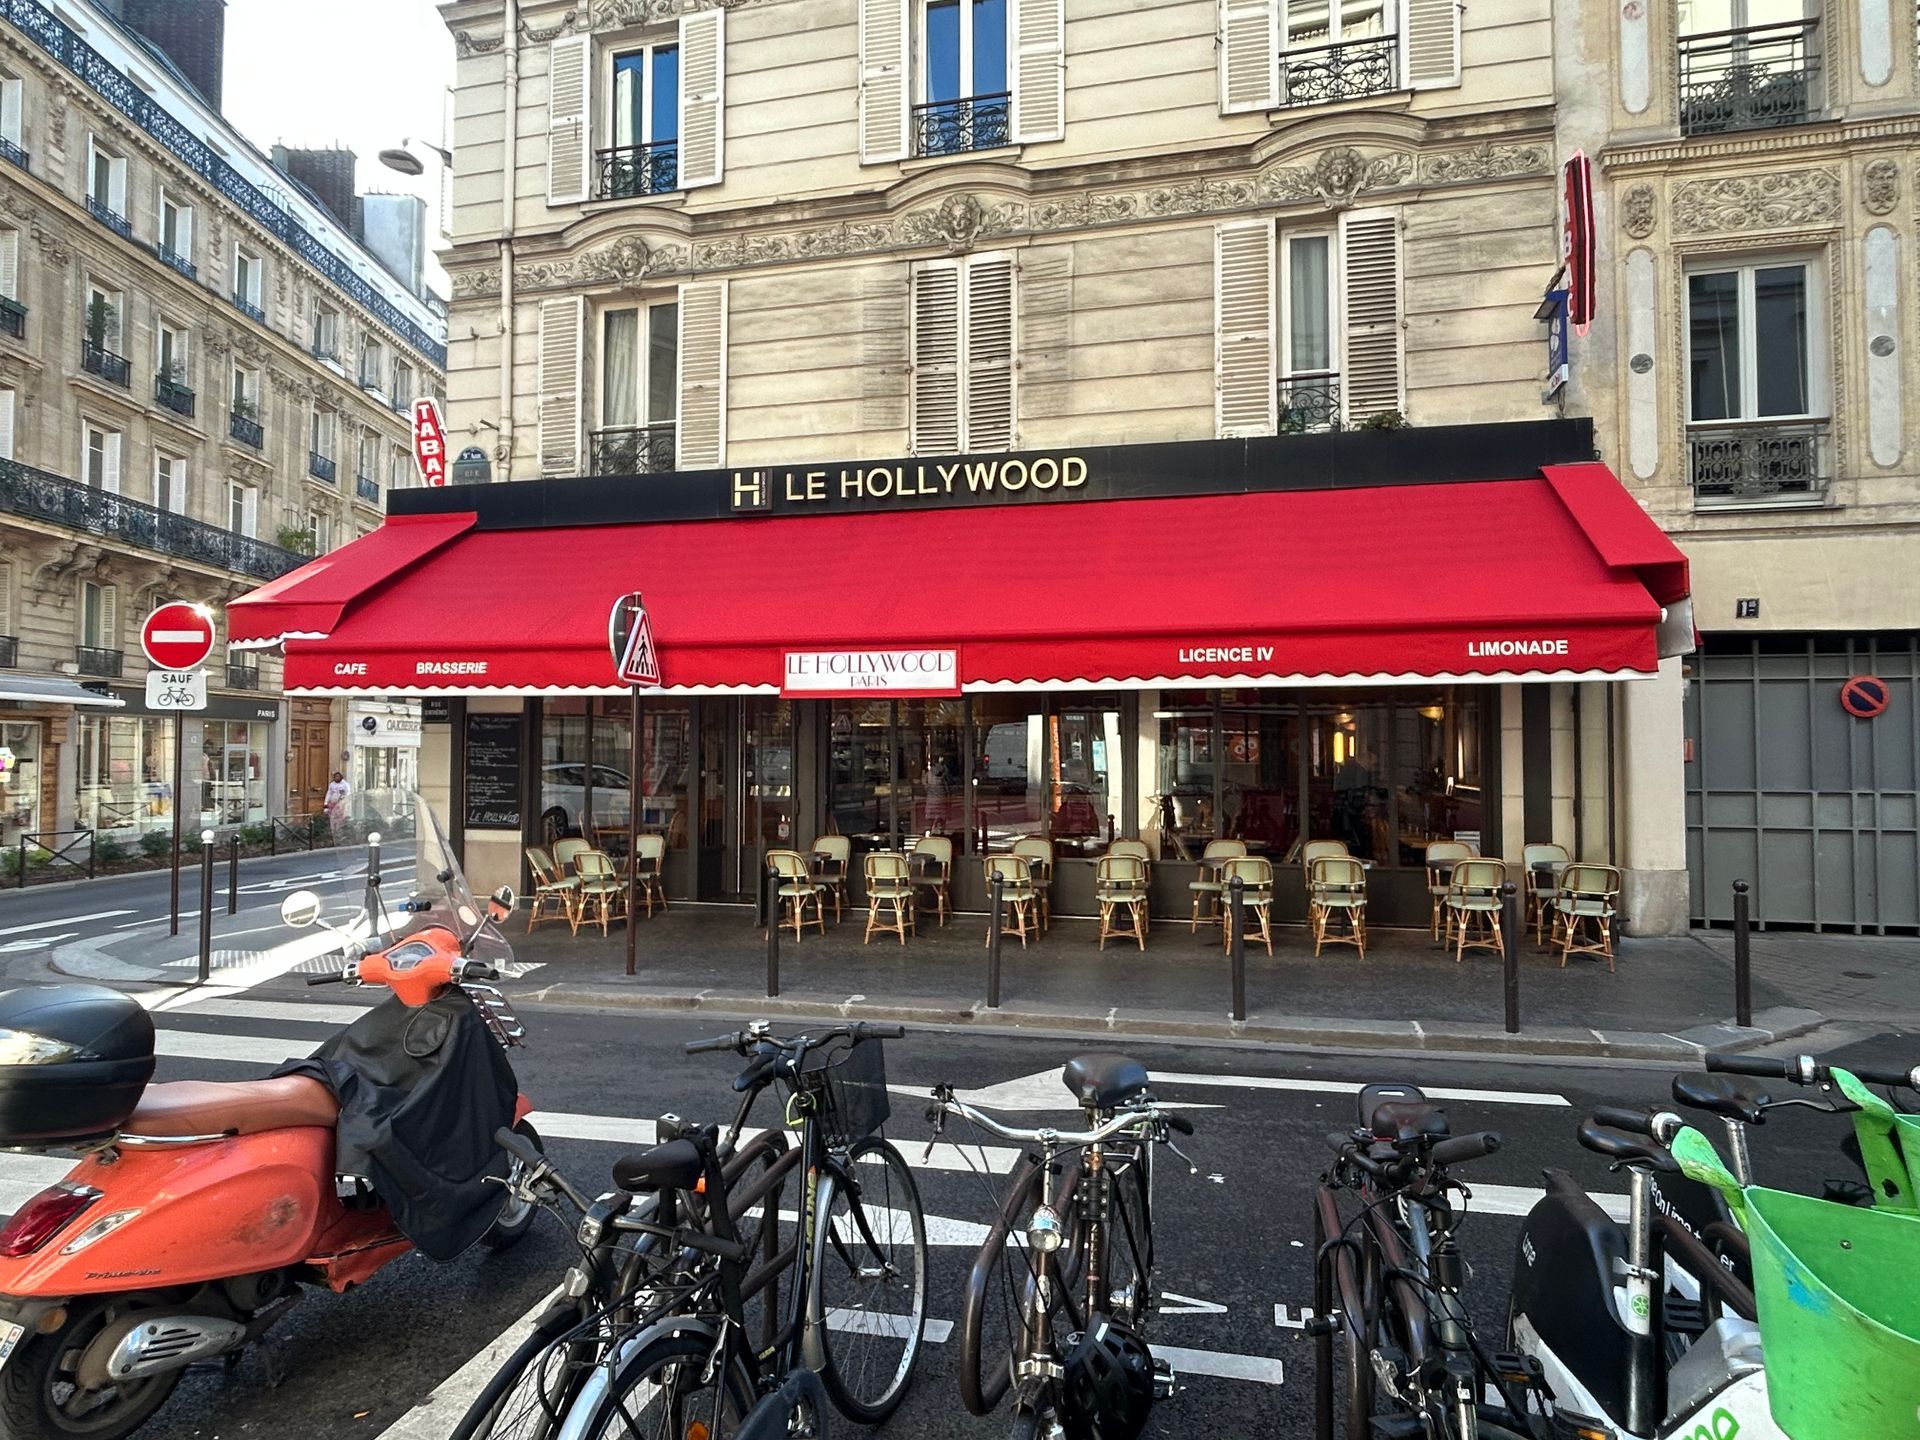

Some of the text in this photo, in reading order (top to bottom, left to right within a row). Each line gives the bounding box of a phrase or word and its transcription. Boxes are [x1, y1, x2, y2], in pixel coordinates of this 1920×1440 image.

[418, 404, 443, 486] TABAC
[786, 457, 1088, 501] LE HOLLYWOOD
[734, 471, 760, 506] H
[1178, 646, 1275, 662] LICENCE IV
[1467, 640, 1570, 657] LIMONADE
[334, 661, 488, 675] CAFE BRASSERIE
[788, 651, 953, 674] LE HOLLYWOOD
[161, 673, 194, 684] SAUF
[850, 674, 888, 688] PARIS
[257, 709, 276, 718] PARIS
